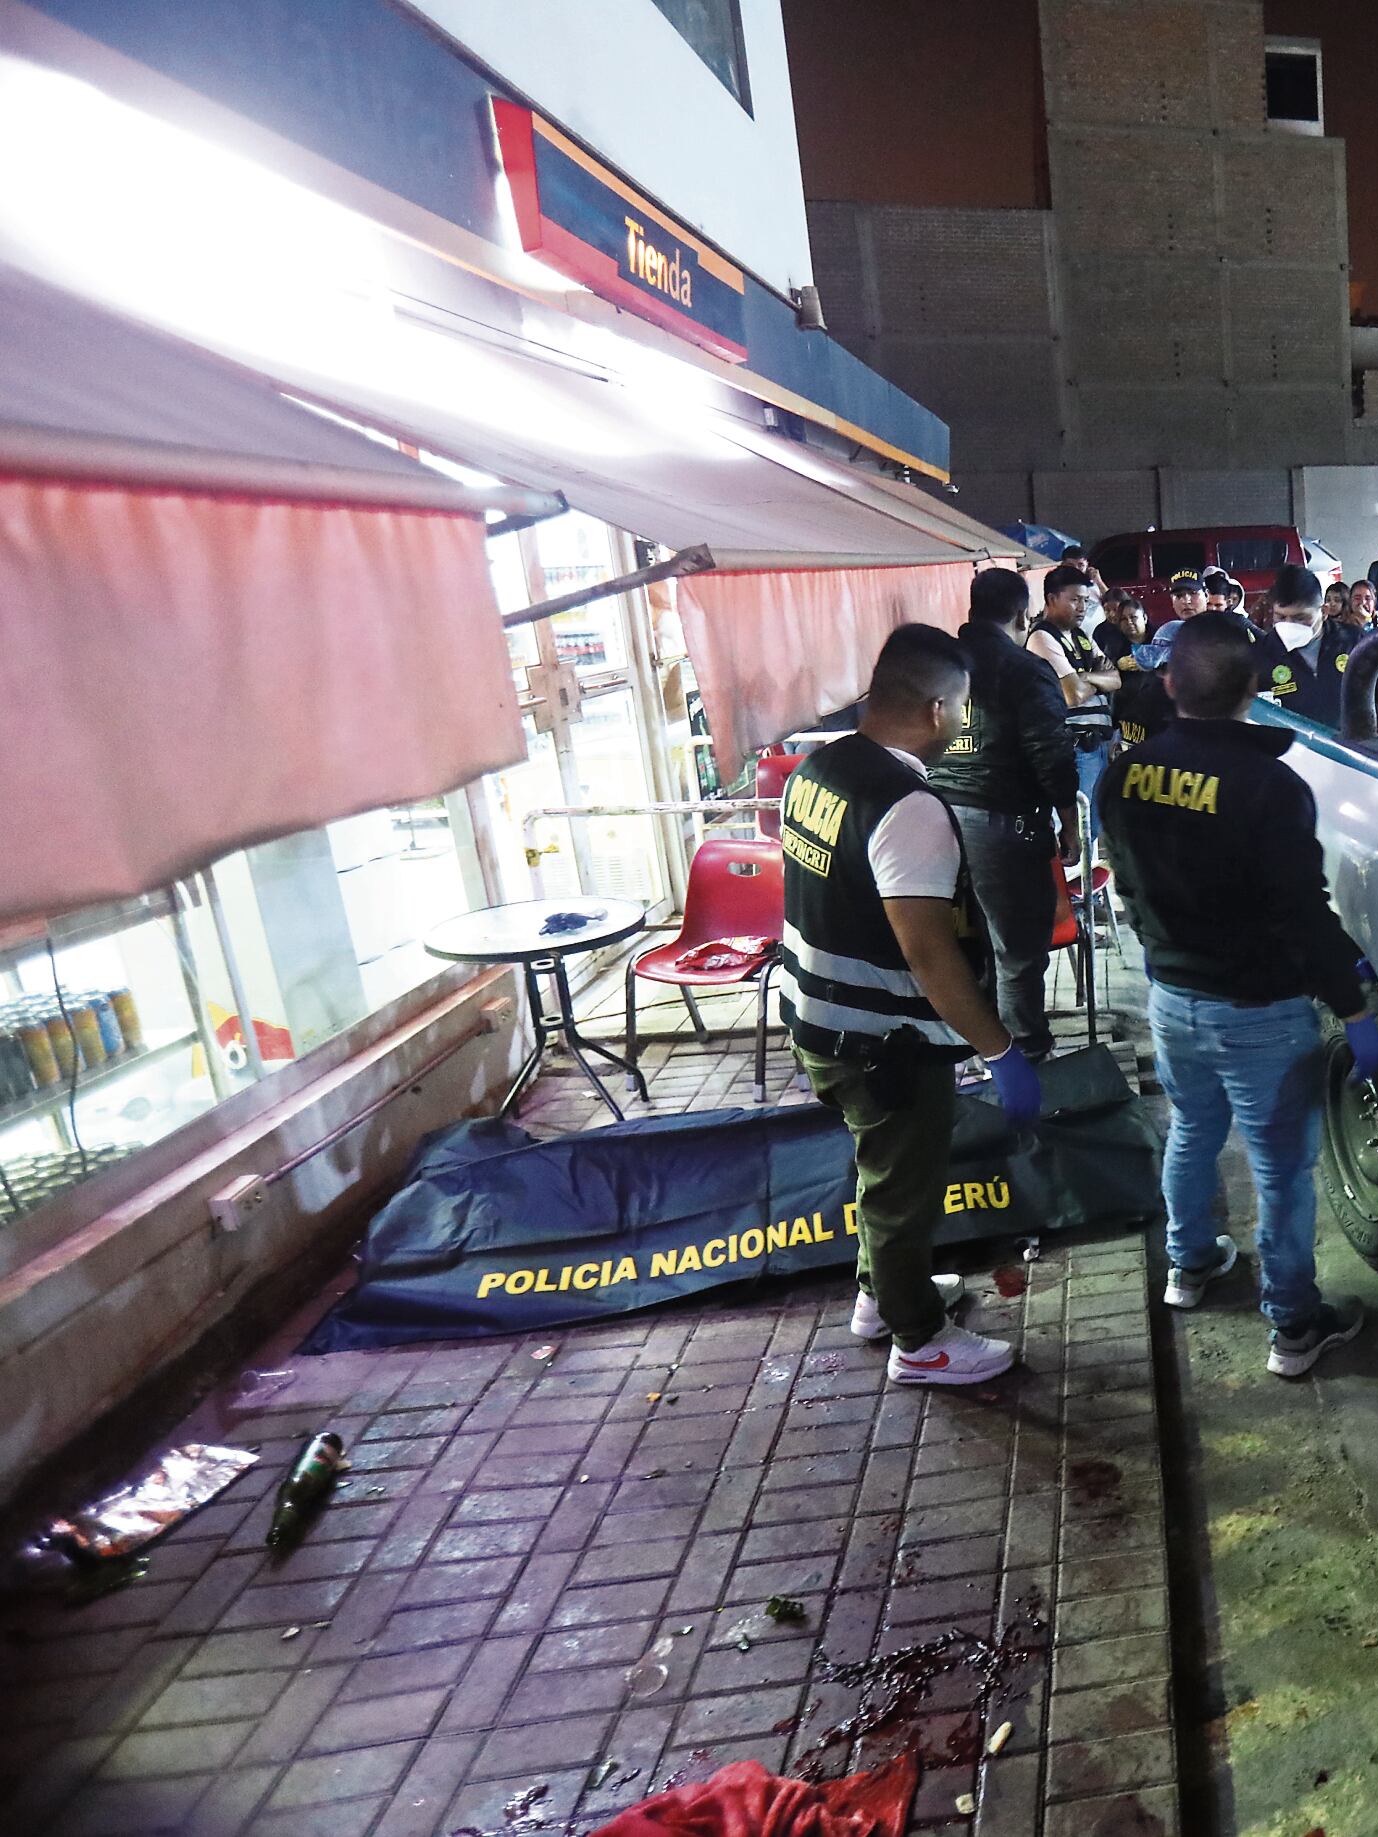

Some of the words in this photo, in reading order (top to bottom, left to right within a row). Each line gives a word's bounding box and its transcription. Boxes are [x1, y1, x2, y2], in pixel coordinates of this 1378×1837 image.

[625, 216, 692, 308] Tienda
[1170, 570, 1198, 583] POLICIA
[1122, 763, 1220, 814] POLICIA
[477, 1256, 637, 1299] POLICIA
[650, 1212, 834, 1278] NACIONAL
[944, 1175, 1011, 1214] ERÚ
